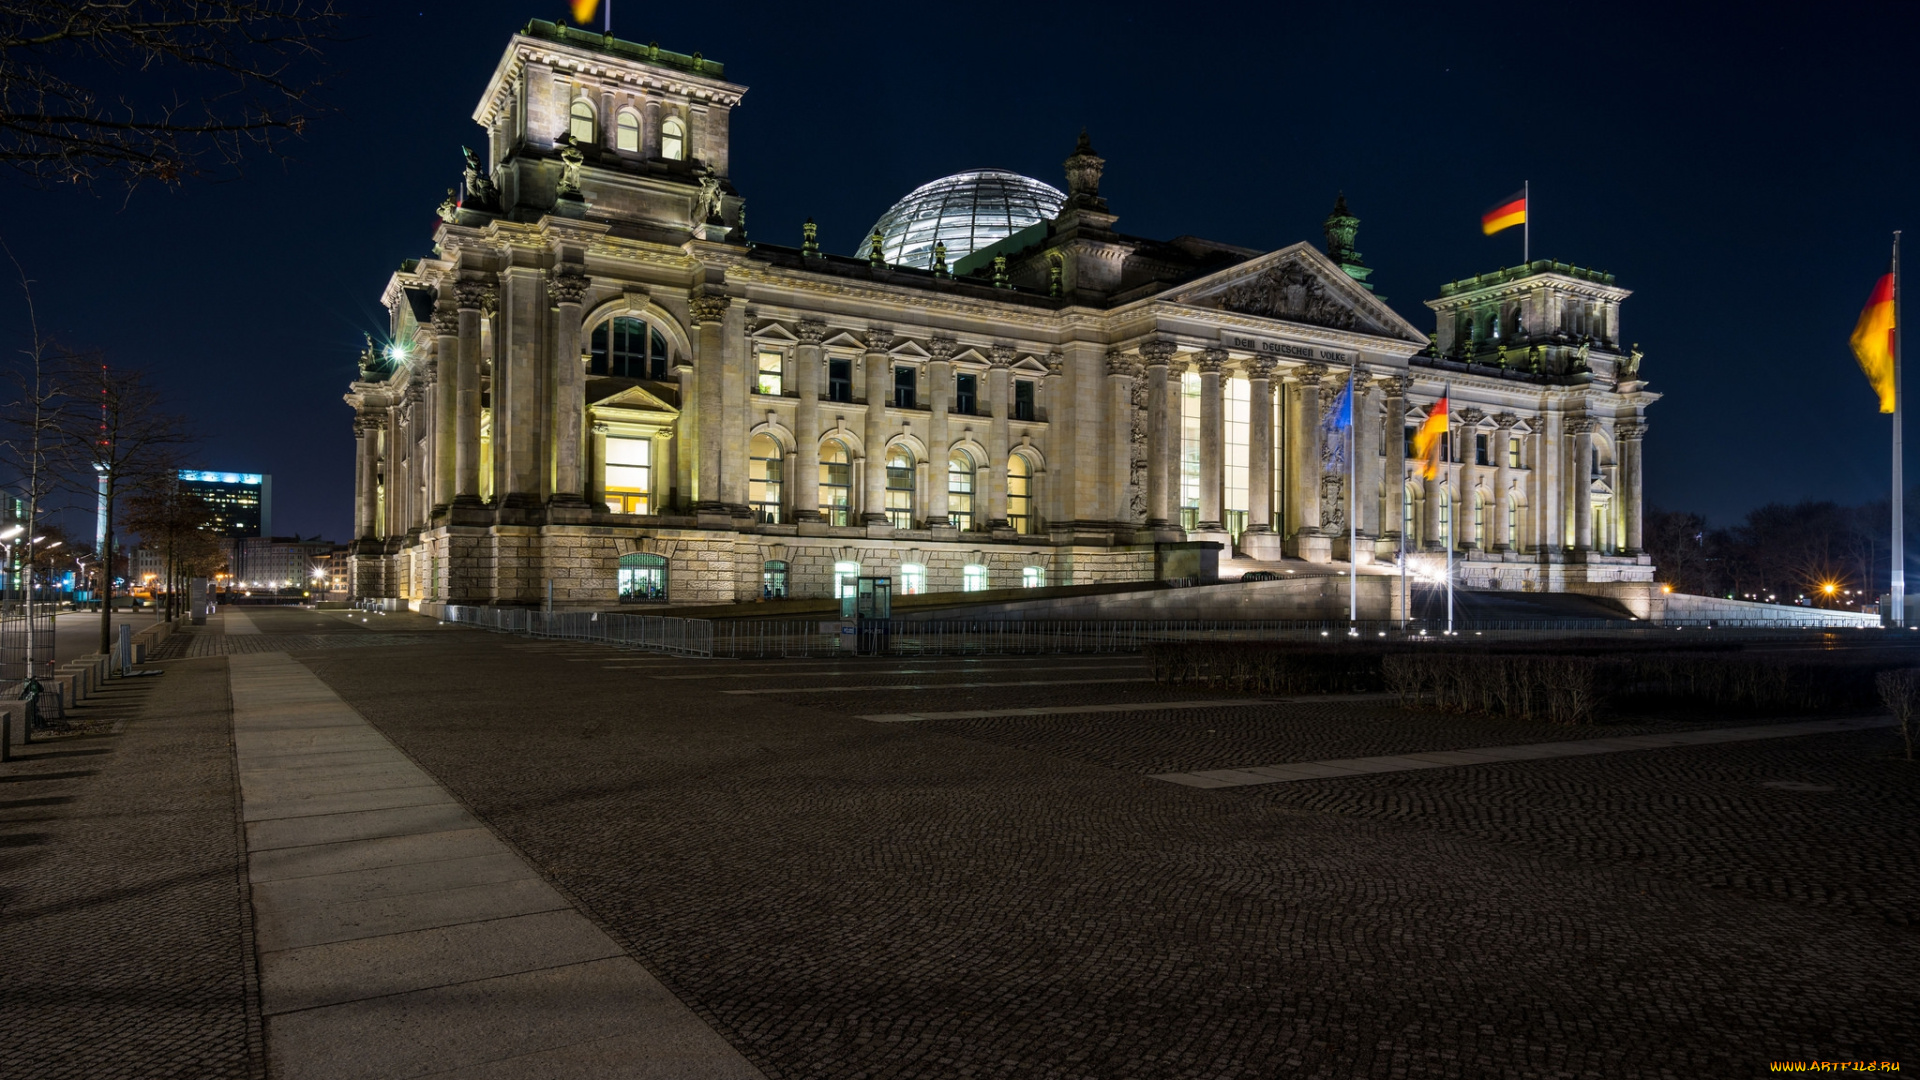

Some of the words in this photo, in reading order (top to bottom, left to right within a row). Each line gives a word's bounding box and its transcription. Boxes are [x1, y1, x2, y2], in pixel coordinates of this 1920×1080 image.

[1234, 337, 1255, 349] DEM
[1262, 342, 1314, 358] DEUTSCHEN
[1320, 350, 1346, 362] VOLKE
